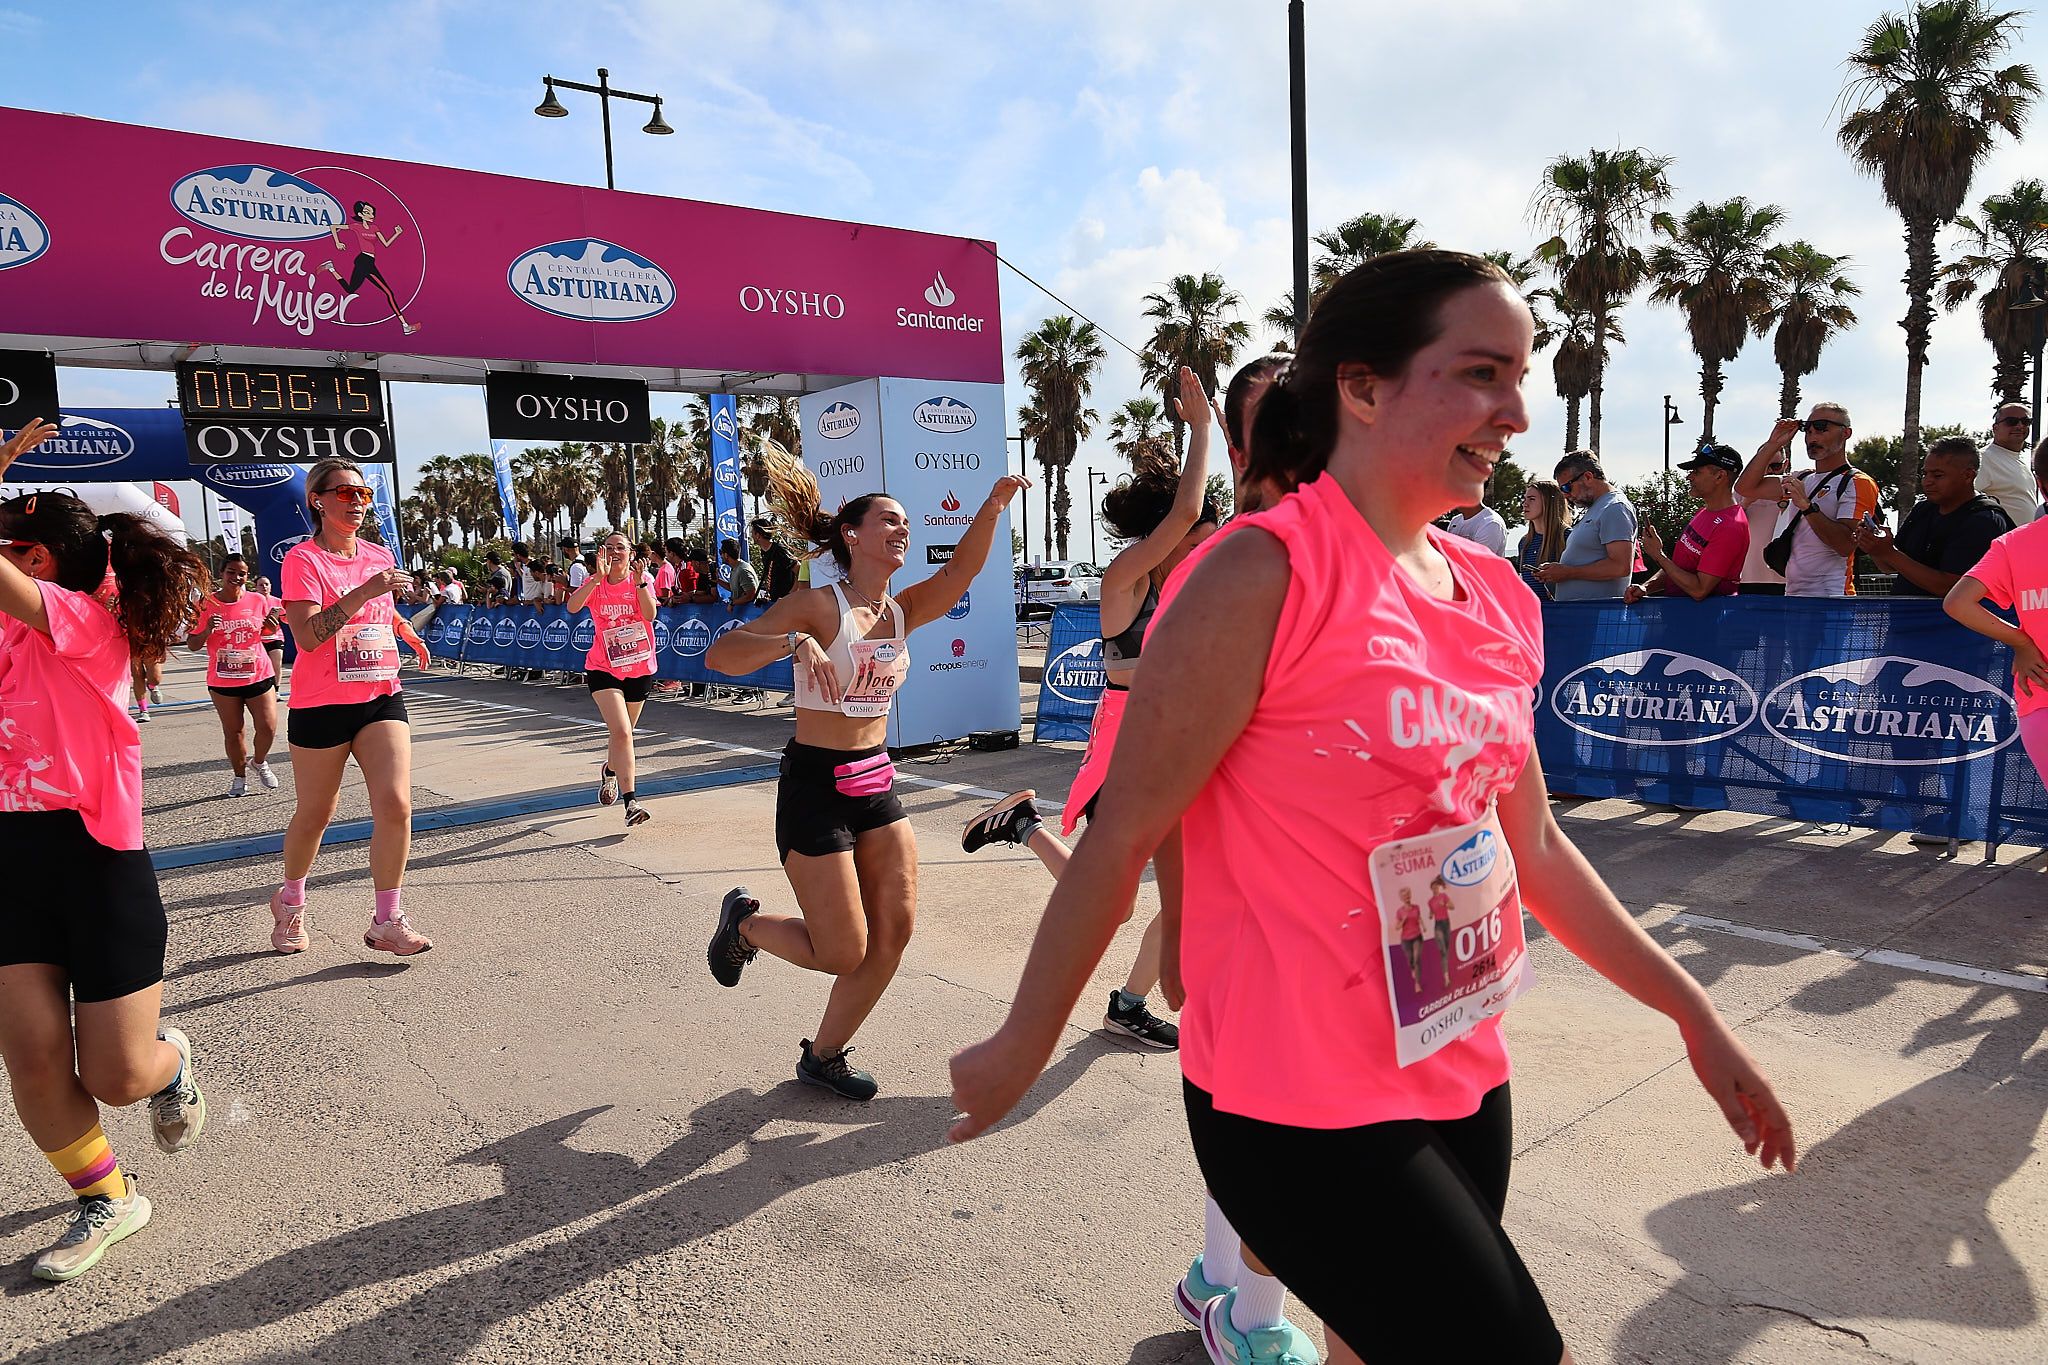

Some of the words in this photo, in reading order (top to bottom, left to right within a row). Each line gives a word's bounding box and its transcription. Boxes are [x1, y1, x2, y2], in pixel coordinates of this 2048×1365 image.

[187, 184, 333, 227] ASTURIANA
[212, 185, 269, 199] CENTRAL
[272, 191, 328, 206] LECHERA
[160, 227, 307, 276] Carrera
[548, 263, 602, 276] CENTRAL
[606, 268, 658, 281] LECHERA
[523, 263, 664, 304] ASTURIANA
[201, 275, 228, 298] de
[234, 272, 254, 300] la
[252, 273, 360, 336] Mujer
[739, 286, 846, 320] OYSHO
[896, 307, 985, 333] Santander
[194, 370, 371, 413] 00:36:15
[516, 394, 629, 424] OYSHO
[919, 409, 973, 425] ASTURIANA
[821, 417, 858, 433] ASTURIANA
[27, 439, 124, 455] URIANA
[197, 425, 381, 459] OYSHO
[819, 455, 865, 477] OYSHO
[915, 452, 980, 471] OYSHO
[214, 468, 290, 481] ASTURIANA
[924, 514, 973, 526] Santande
[360, 650, 384, 661] 016
[621, 641, 638, 651] 016
[871, 675, 896, 688] 016
[1598, 679, 1664, 692] CENTRAL
[1667, 682, 1736, 696] LECHERA
[849, 705, 874, 713] OYSHO
[1564, 680, 1739, 725] ASTURIANA
[1819, 689, 1898, 704] CENTRAL
[1907, 695, 1995, 709] LECHERA
[1776, 691, 1999, 744] ASTURIANA
[1395, 857, 1436, 876] SUMA
[1455, 907, 1502, 964] 016
[1472, 954, 1496, 979] 2614
[1453, 987, 1465, 1000] DE
[1466, 982, 1477, 994] LA
[1420, 1006, 1464, 1046] OYSHO
